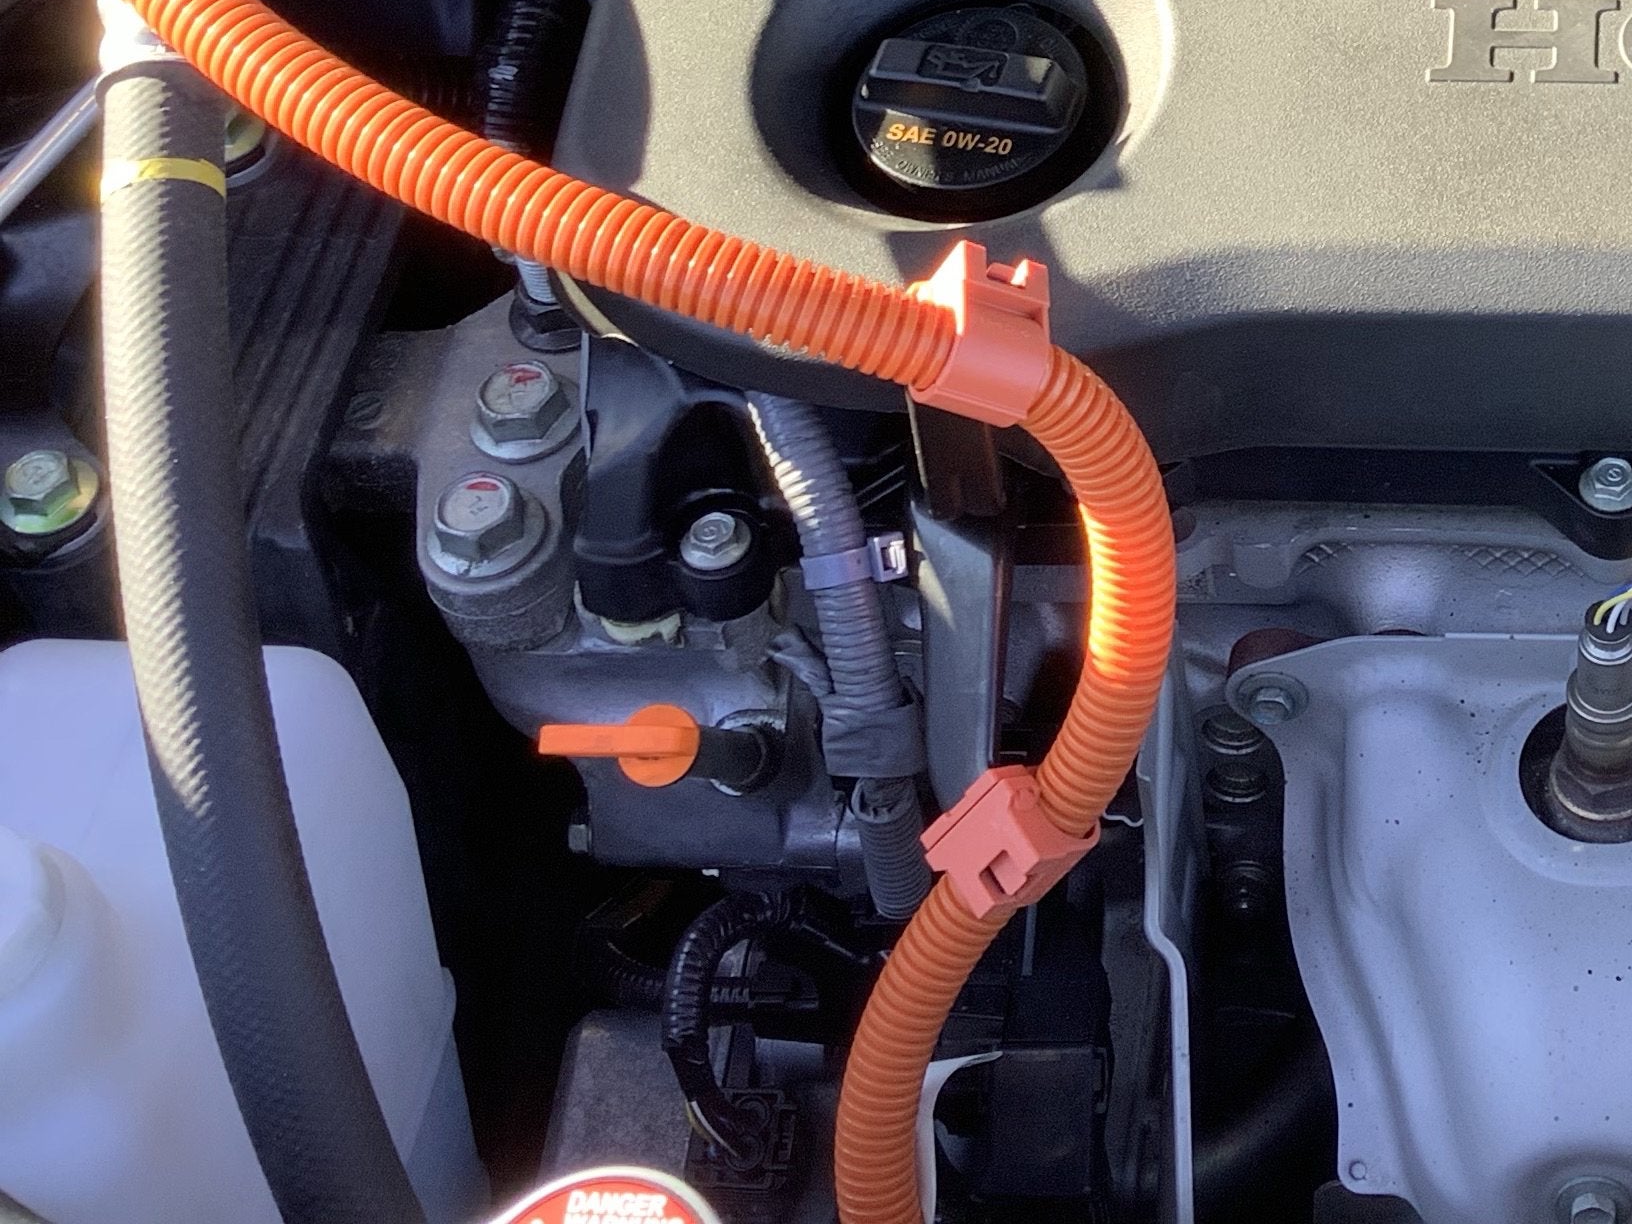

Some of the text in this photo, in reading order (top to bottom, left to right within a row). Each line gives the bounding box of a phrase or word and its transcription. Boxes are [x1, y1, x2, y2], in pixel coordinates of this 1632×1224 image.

[885, 122, 1014, 156] SAE 0W-20
[566, 1190, 668, 1217] DANGER
